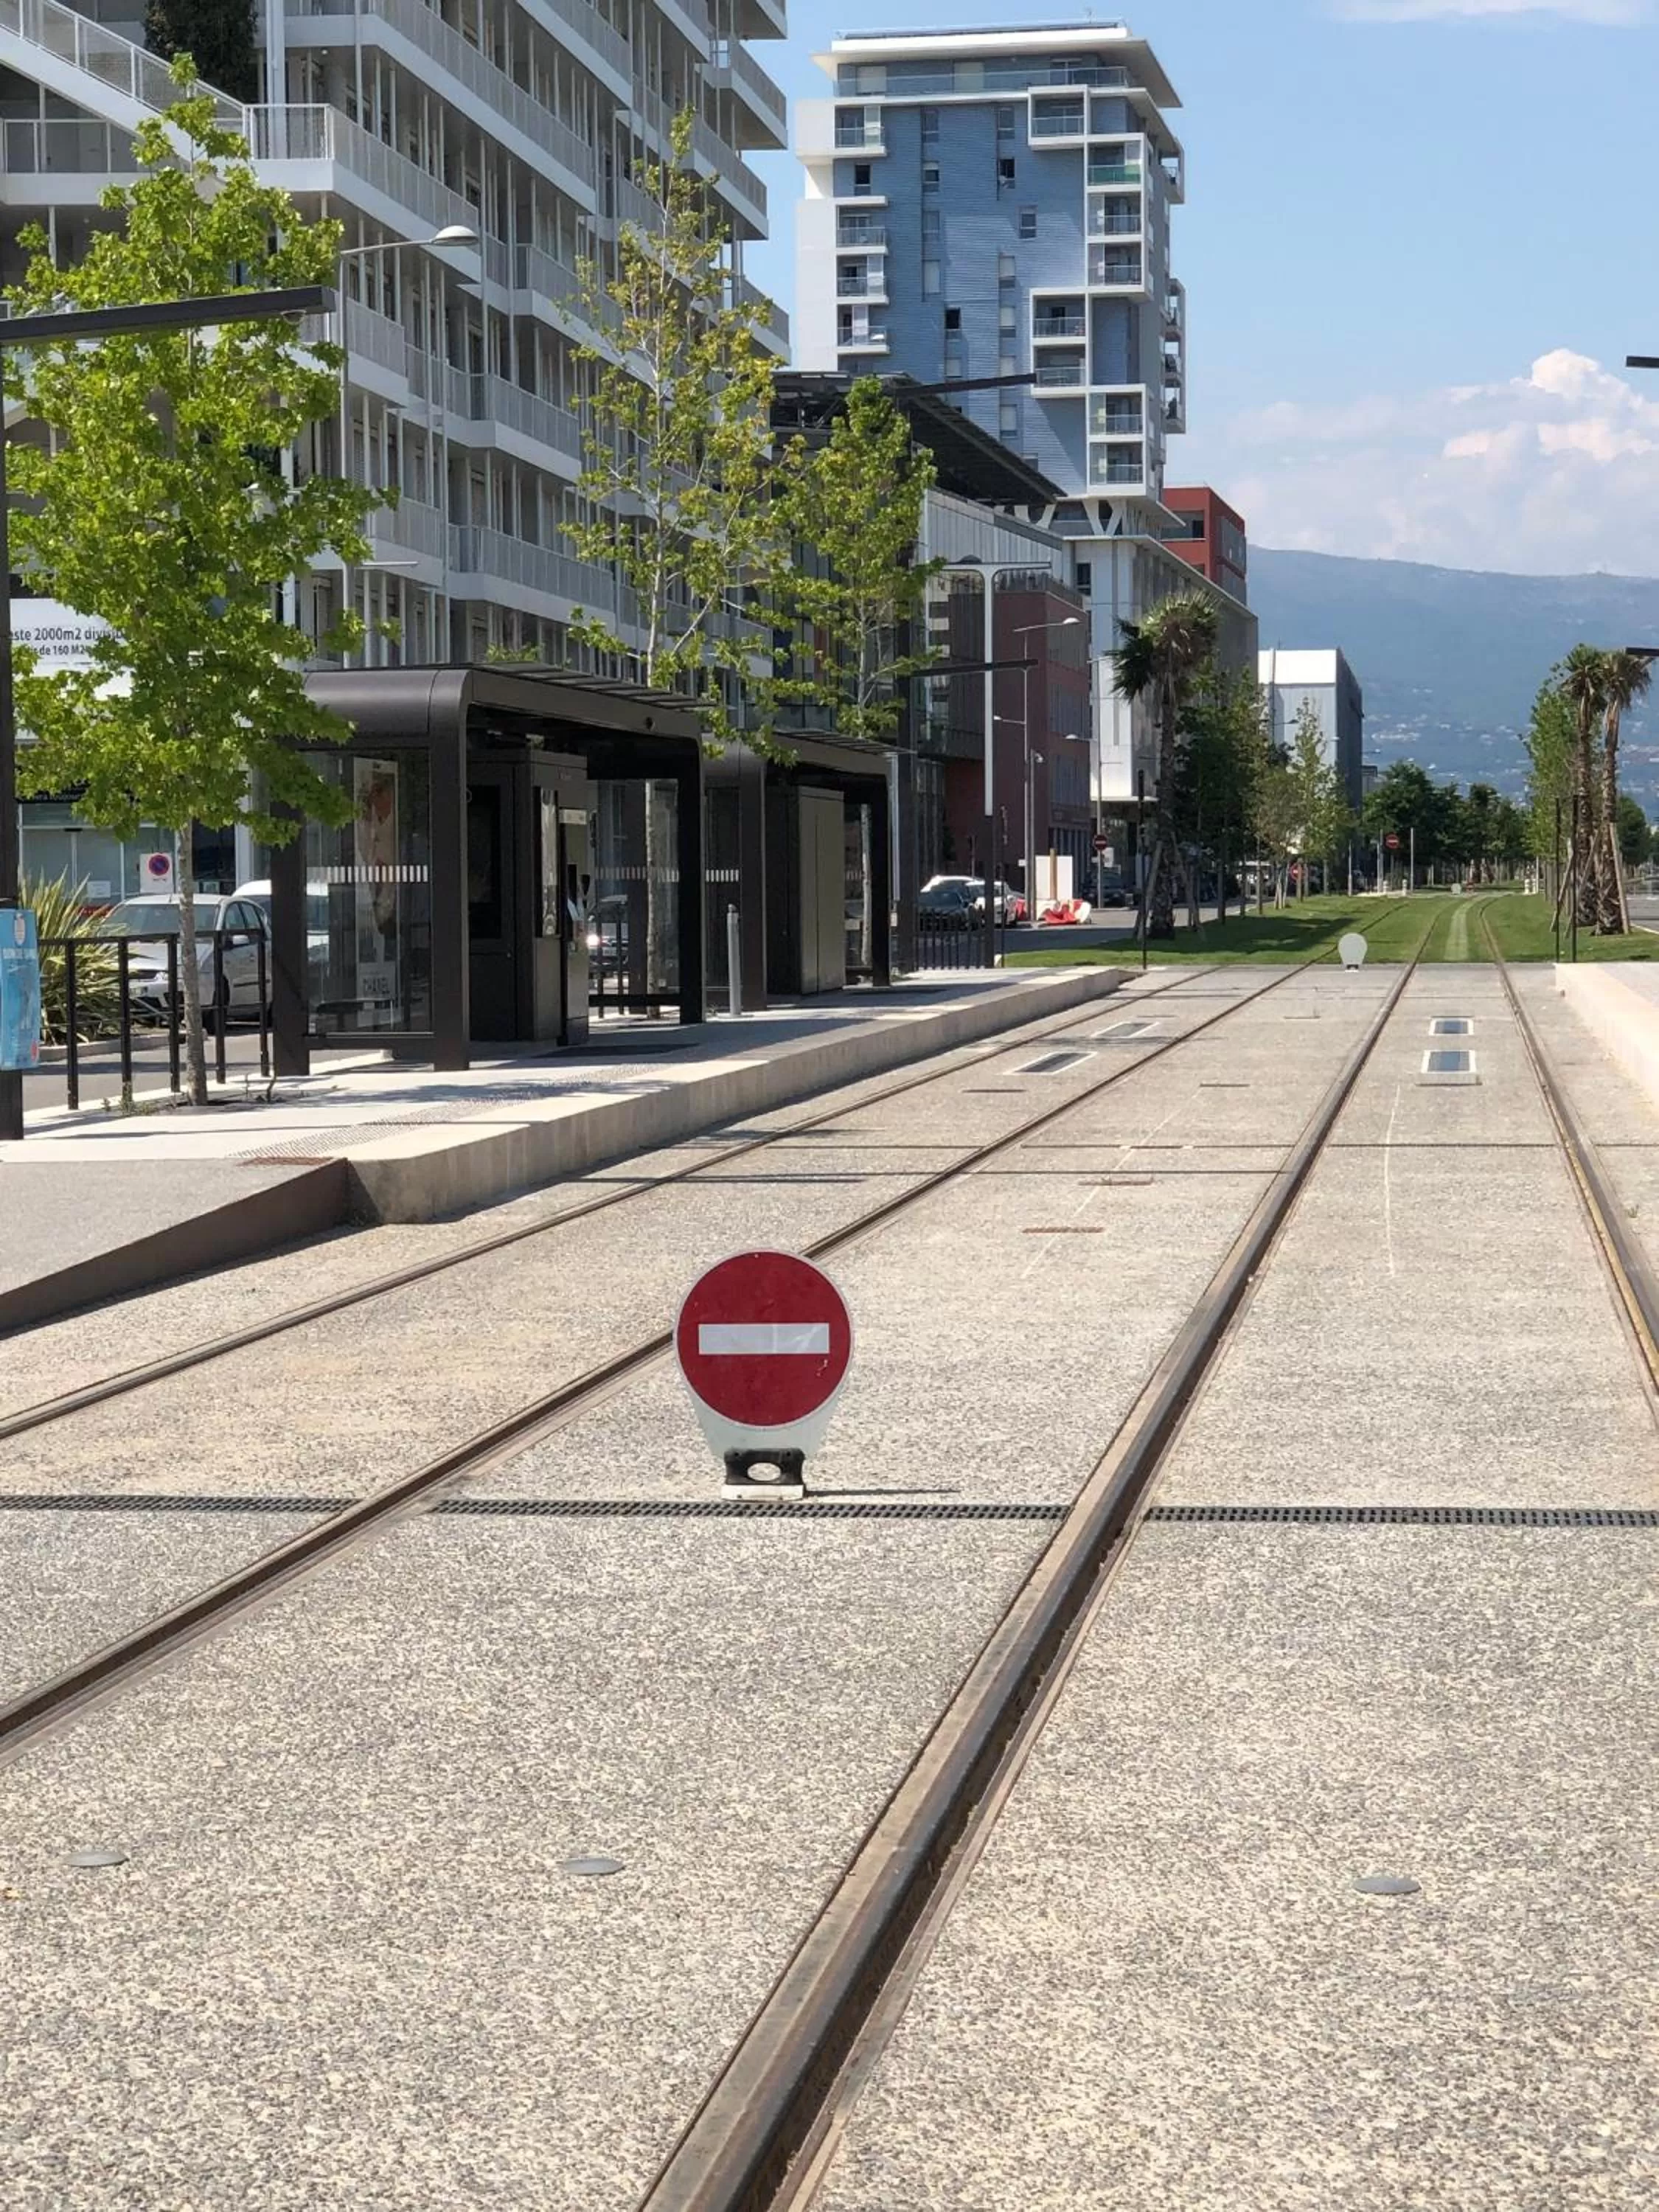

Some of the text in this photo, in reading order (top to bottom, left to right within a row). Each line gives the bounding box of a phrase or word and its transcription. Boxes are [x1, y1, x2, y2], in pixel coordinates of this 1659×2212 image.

[34, 627, 81, 641] 2000m2
[39, 644, 51, 655] de
[52, 645, 69, 655] 160
